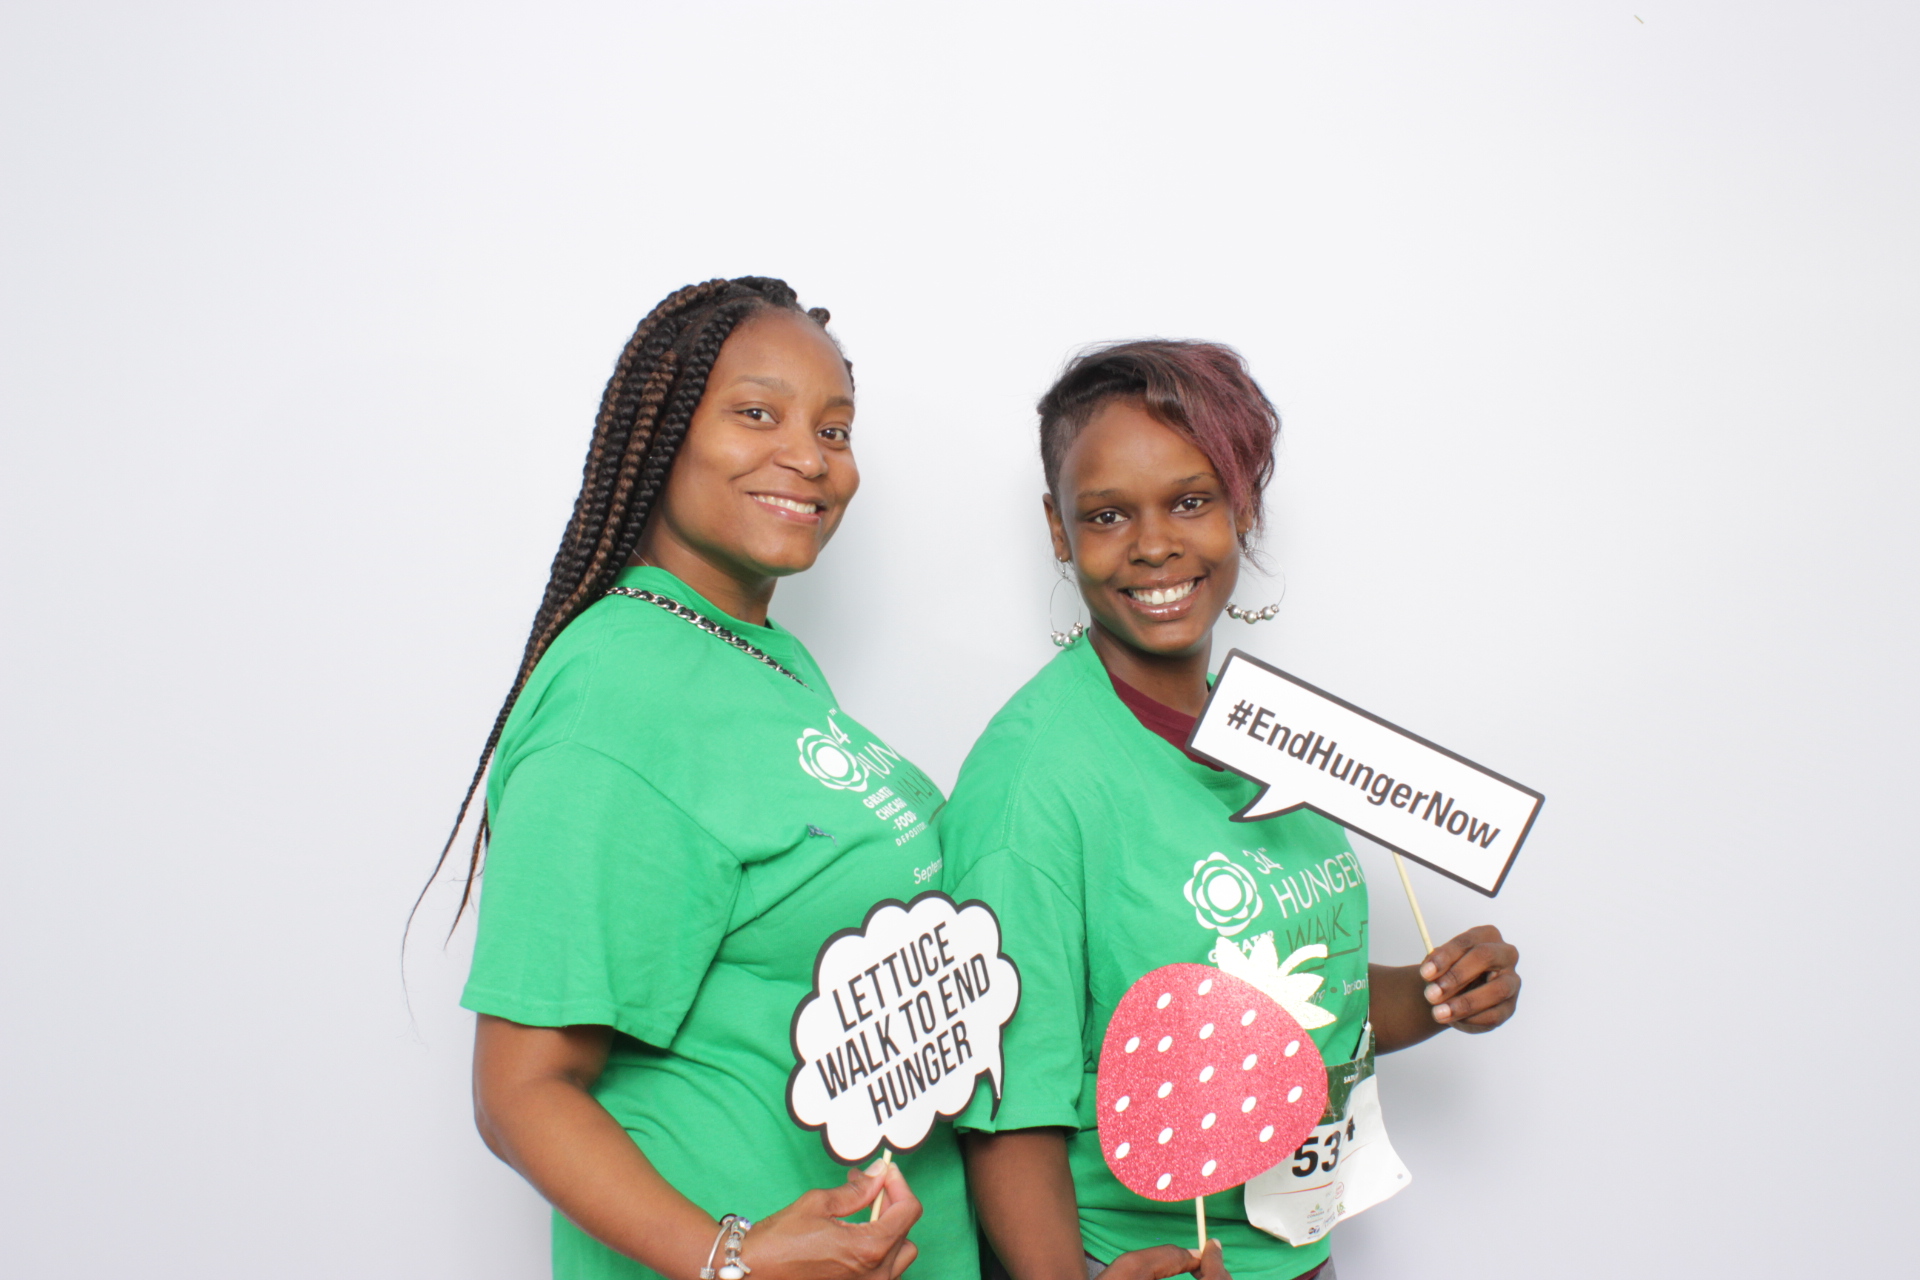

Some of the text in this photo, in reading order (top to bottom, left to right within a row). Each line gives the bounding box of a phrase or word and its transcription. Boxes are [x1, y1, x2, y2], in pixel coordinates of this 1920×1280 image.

[827, 707, 852, 745] 4TH
[1227, 699, 1501, 849] #EndHungerNow
[1269, 851, 1366, 919] HUNGER
[815, 953, 990, 1100] WALK TO END
[832, 921, 955, 1033] LETTUCE
[868, 1020, 973, 1126] HUNGER
